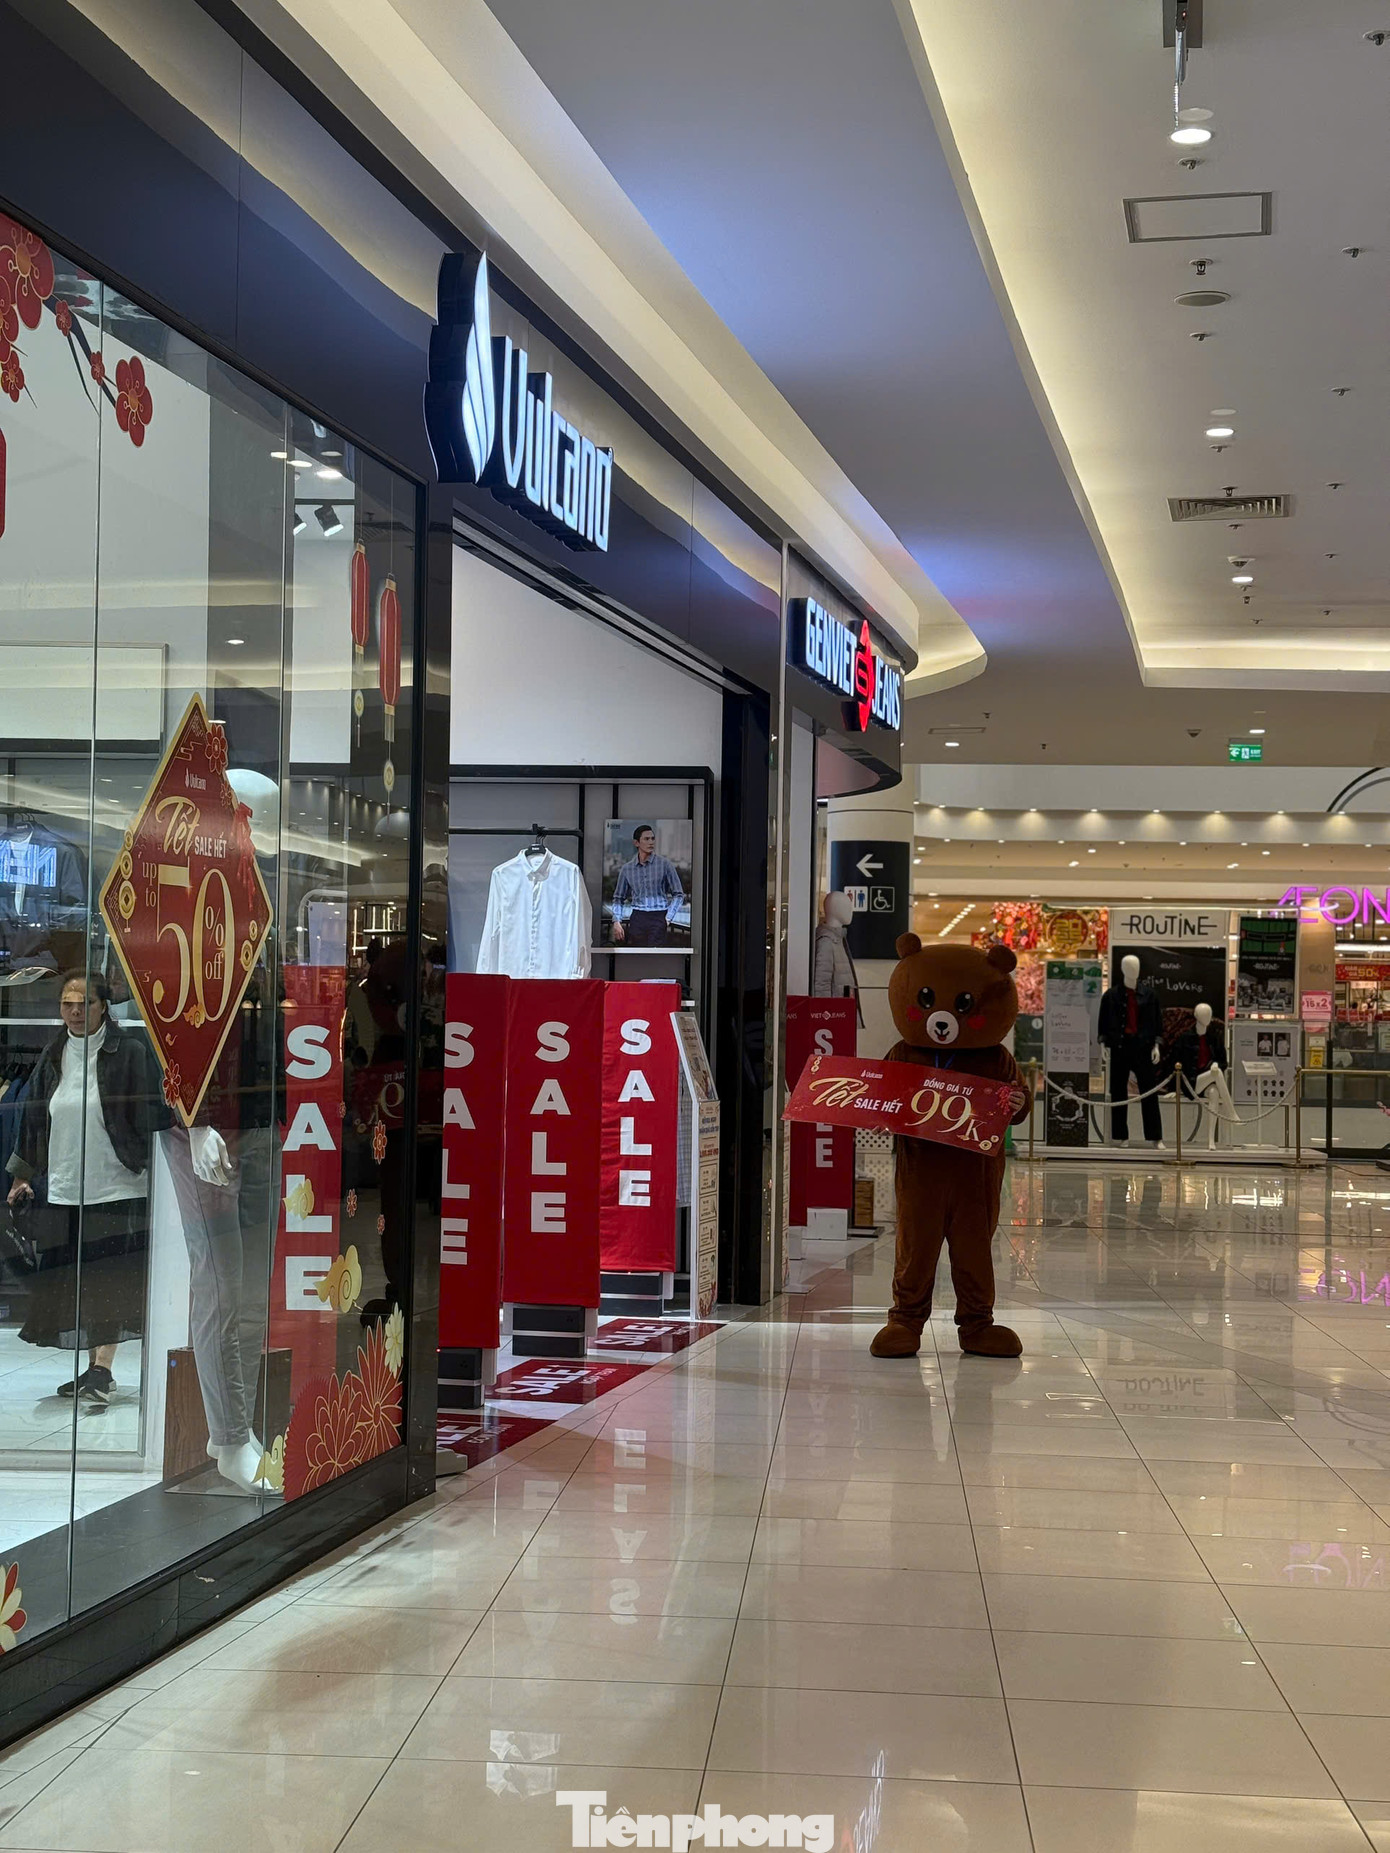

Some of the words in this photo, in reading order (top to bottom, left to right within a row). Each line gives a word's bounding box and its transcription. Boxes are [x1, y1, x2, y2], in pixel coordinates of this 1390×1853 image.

[502, 336, 613, 552] Vulcano
[806, 597, 857, 697] GENVIET
[872, 655, 900, 731] JEANS
[155, 795, 201, 856] Tết
[194, 835, 212, 856] SALE
[214, 831, 227, 859] HẾT
[142, 861, 157, 886] up
[145, 889, 157, 907] to
[205, 951, 225, 980] off
[808, 1077, 870, 1109] Tết
[946, 1082, 960, 1094] GIÁ
[618, 1018, 655, 1208] SALE
[853, 1097, 881, 1112] SALE
[881, 1099, 904, 1114] HẾT
[529, 1020, 571, 1234] SALE
[439, 1022, 476, 1265] SALE
[282, 1024, 337, 1311] SALE
[494, 1366, 593, 1396] SALE
